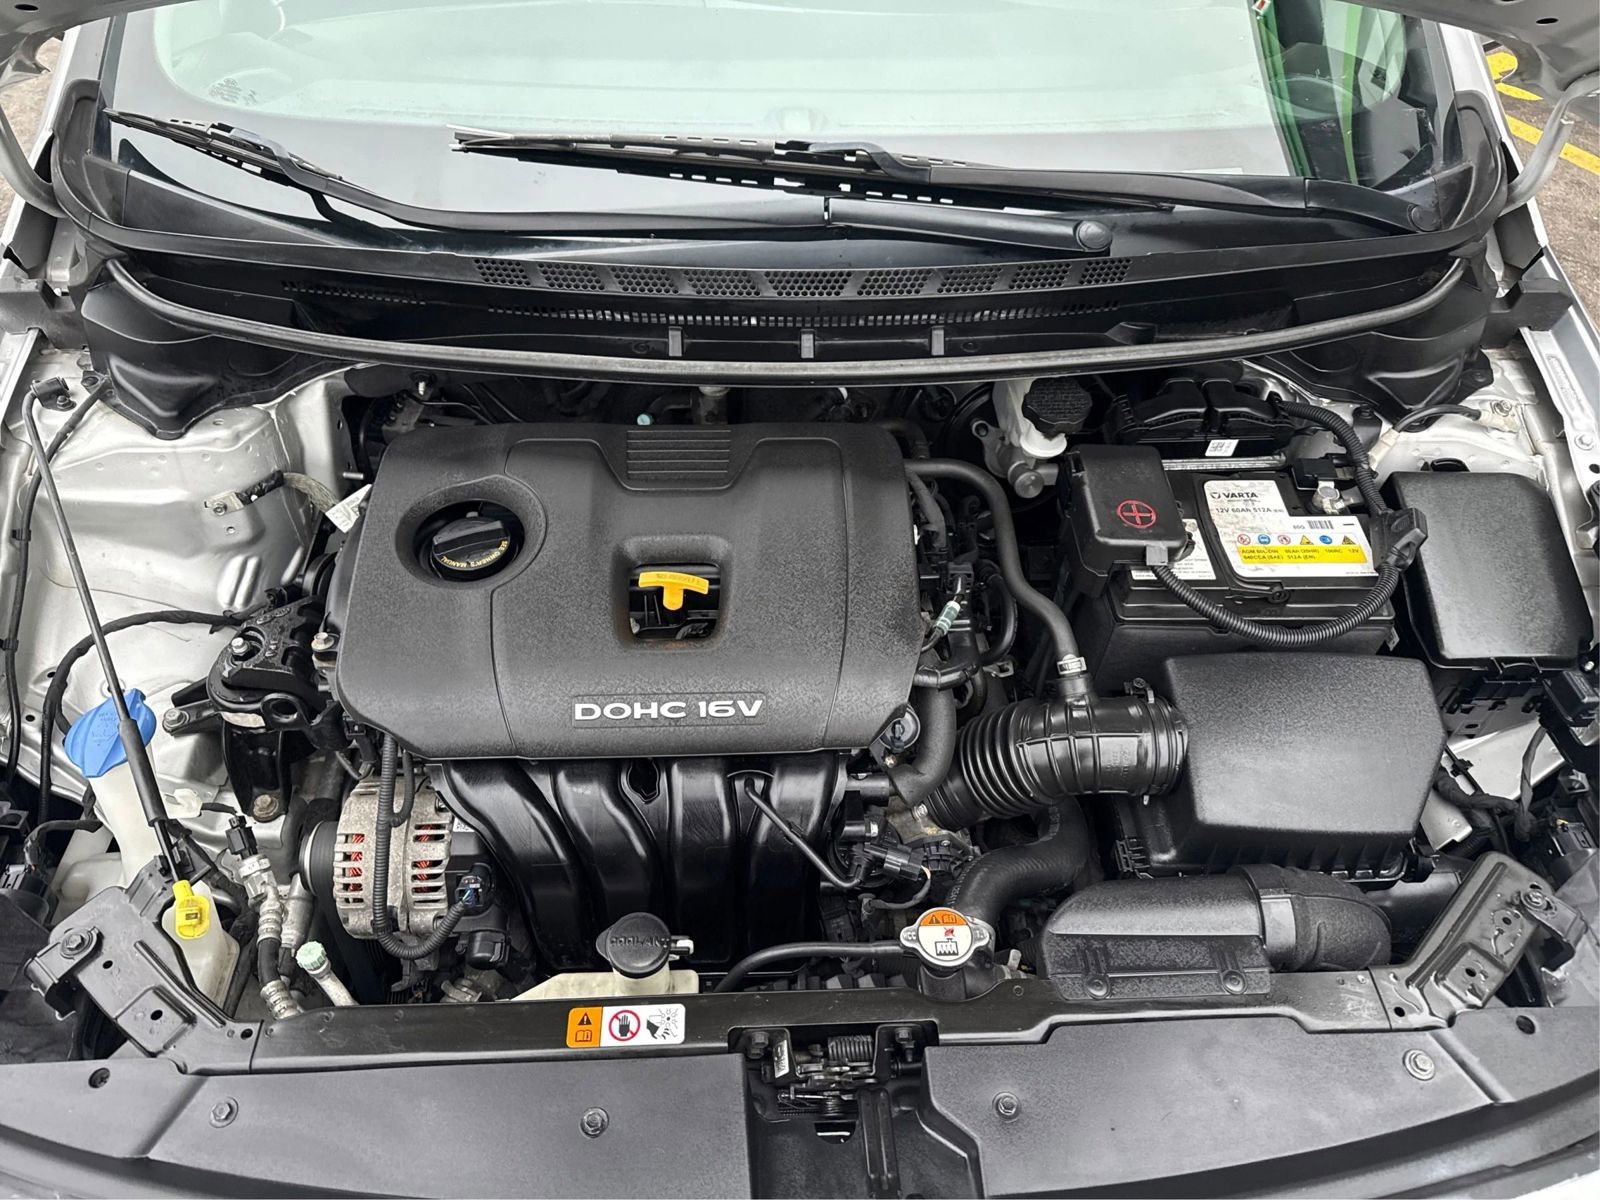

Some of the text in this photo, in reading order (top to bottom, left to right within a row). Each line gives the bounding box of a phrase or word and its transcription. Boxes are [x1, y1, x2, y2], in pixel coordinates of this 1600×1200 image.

[440, 555, 467, 568] MANUAL
[470, 551, 501, 568] OWNER'S
[574, 700, 764, 720] DOHC 16V
